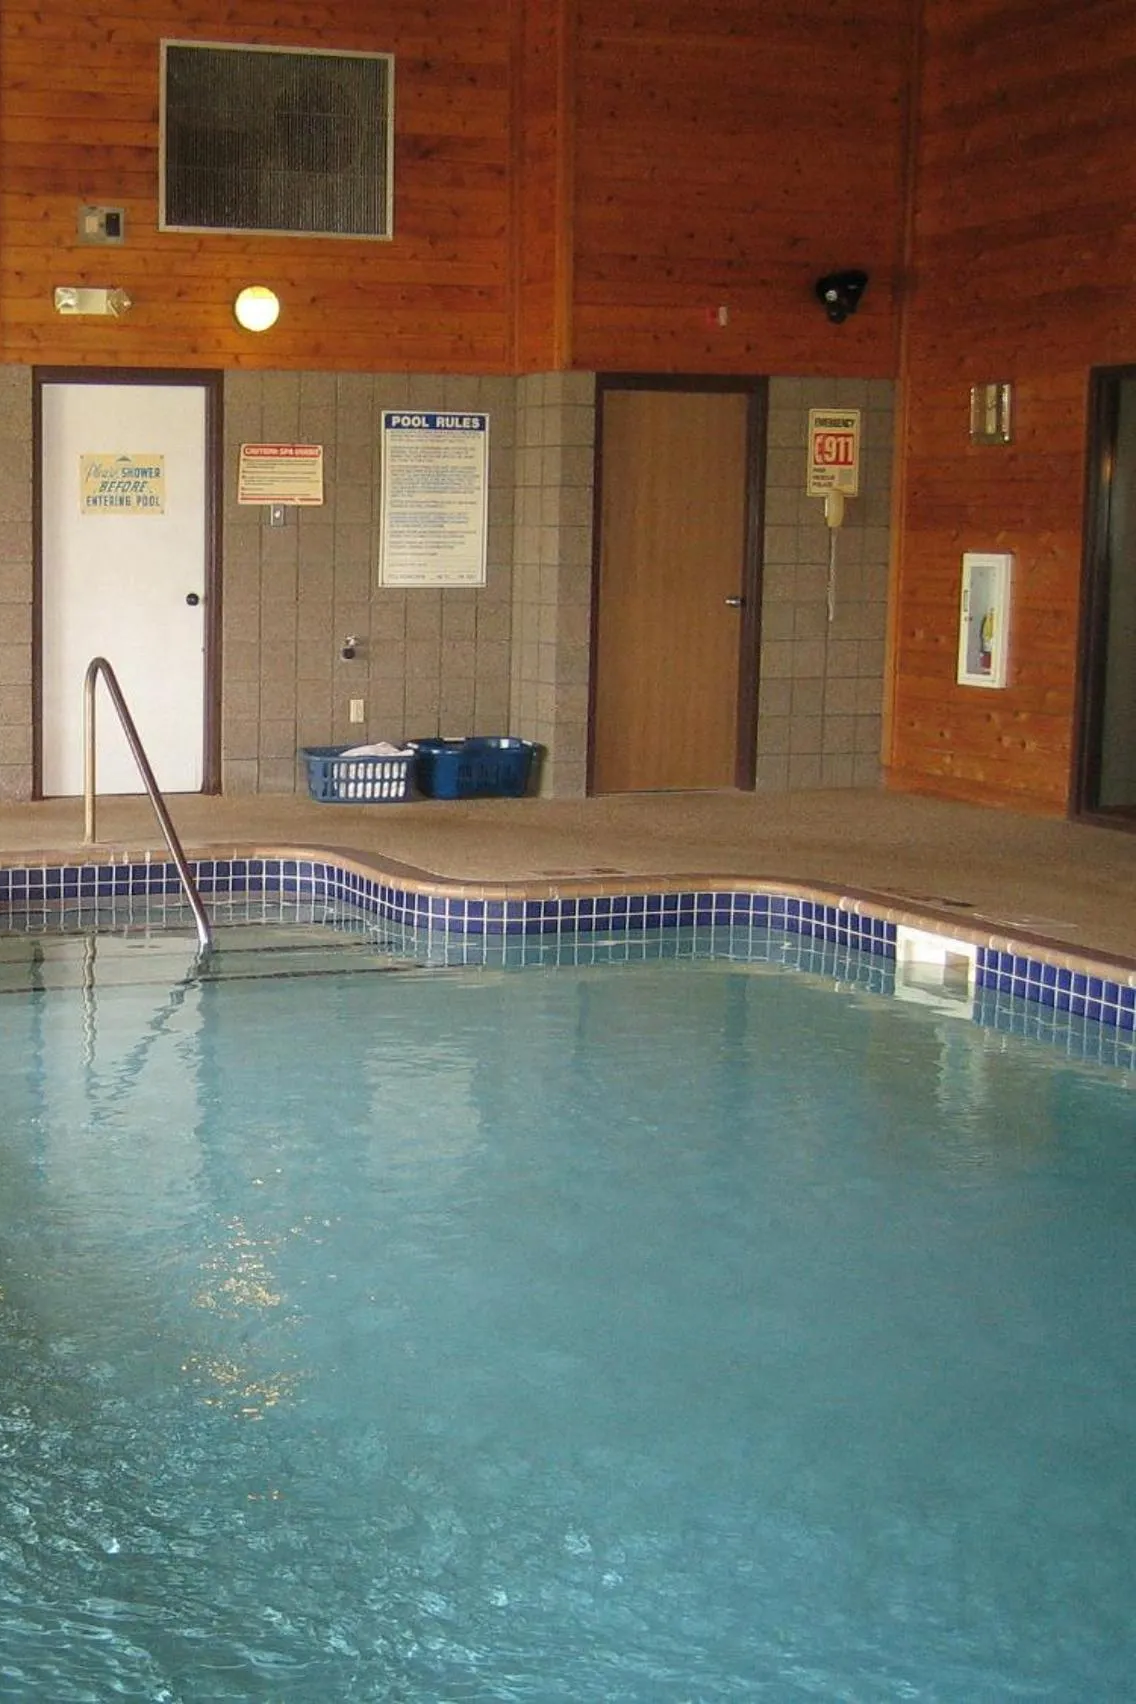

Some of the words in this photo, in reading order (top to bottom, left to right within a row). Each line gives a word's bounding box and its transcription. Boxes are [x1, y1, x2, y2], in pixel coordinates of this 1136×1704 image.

[392, 416, 429, 428] POOL
[436, 417, 481, 429] RULES
[121, 467, 161, 478] SHOWER
[99, 481, 149, 493] BEFORE
[86, 495, 131, 507] ENTERING
[135, 495, 161, 507] POOL
